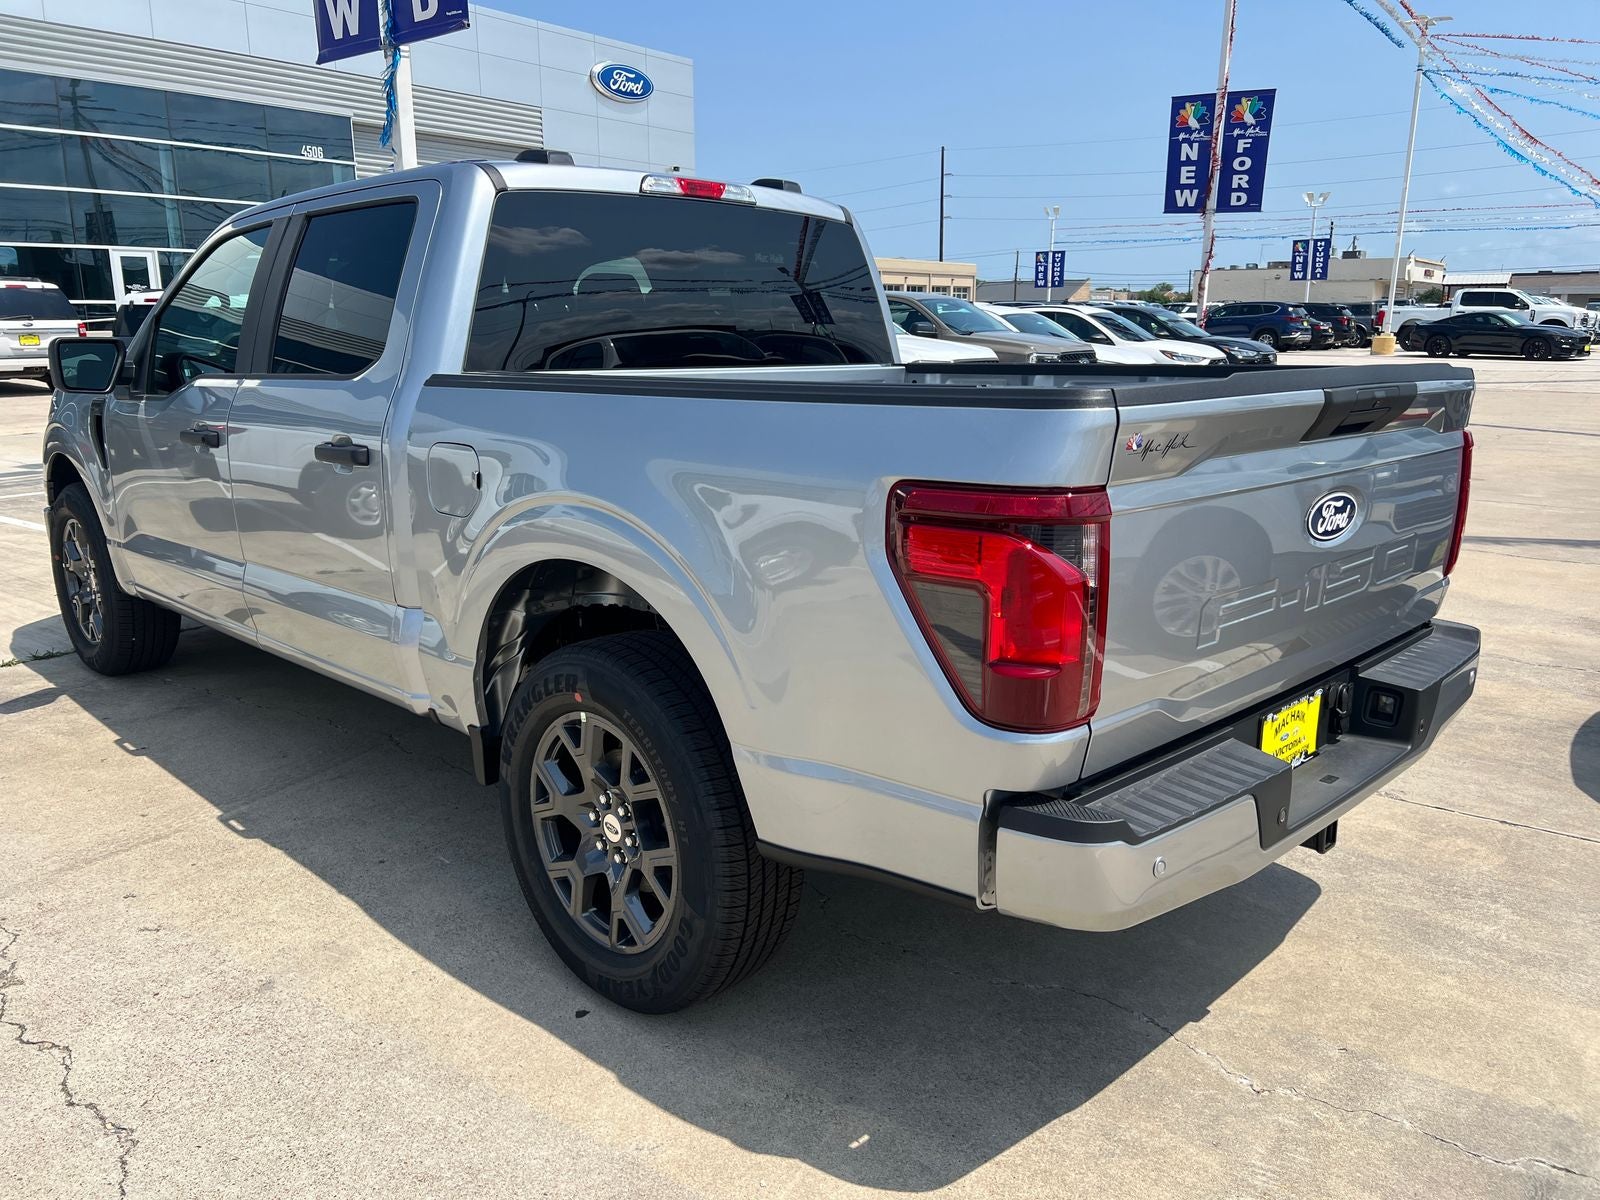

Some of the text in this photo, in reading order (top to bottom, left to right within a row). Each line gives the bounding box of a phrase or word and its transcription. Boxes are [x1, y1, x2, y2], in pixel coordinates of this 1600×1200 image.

[609, 69, 644, 95] Ford
[301, 145, 324, 159] 4506
[1175, 142, 1199, 207] NEW
[1230, 138, 1253, 206] FORD
[1037, 265, 1045, 286] NEW
[1053, 253, 1062, 286] HYUNDAI
[1293, 255, 1304, 279] NEW
[1315, 241, 1325, 278] HYUNDAI
[1317, 499, 1352, 535] Ford
[1196, 533, 1420, 650] F-150
[501, 672, 579, 766] WRANGLER
[1273, 713, 1290, 737] MAC
[622, 708, 680, 806] TERRITORY
